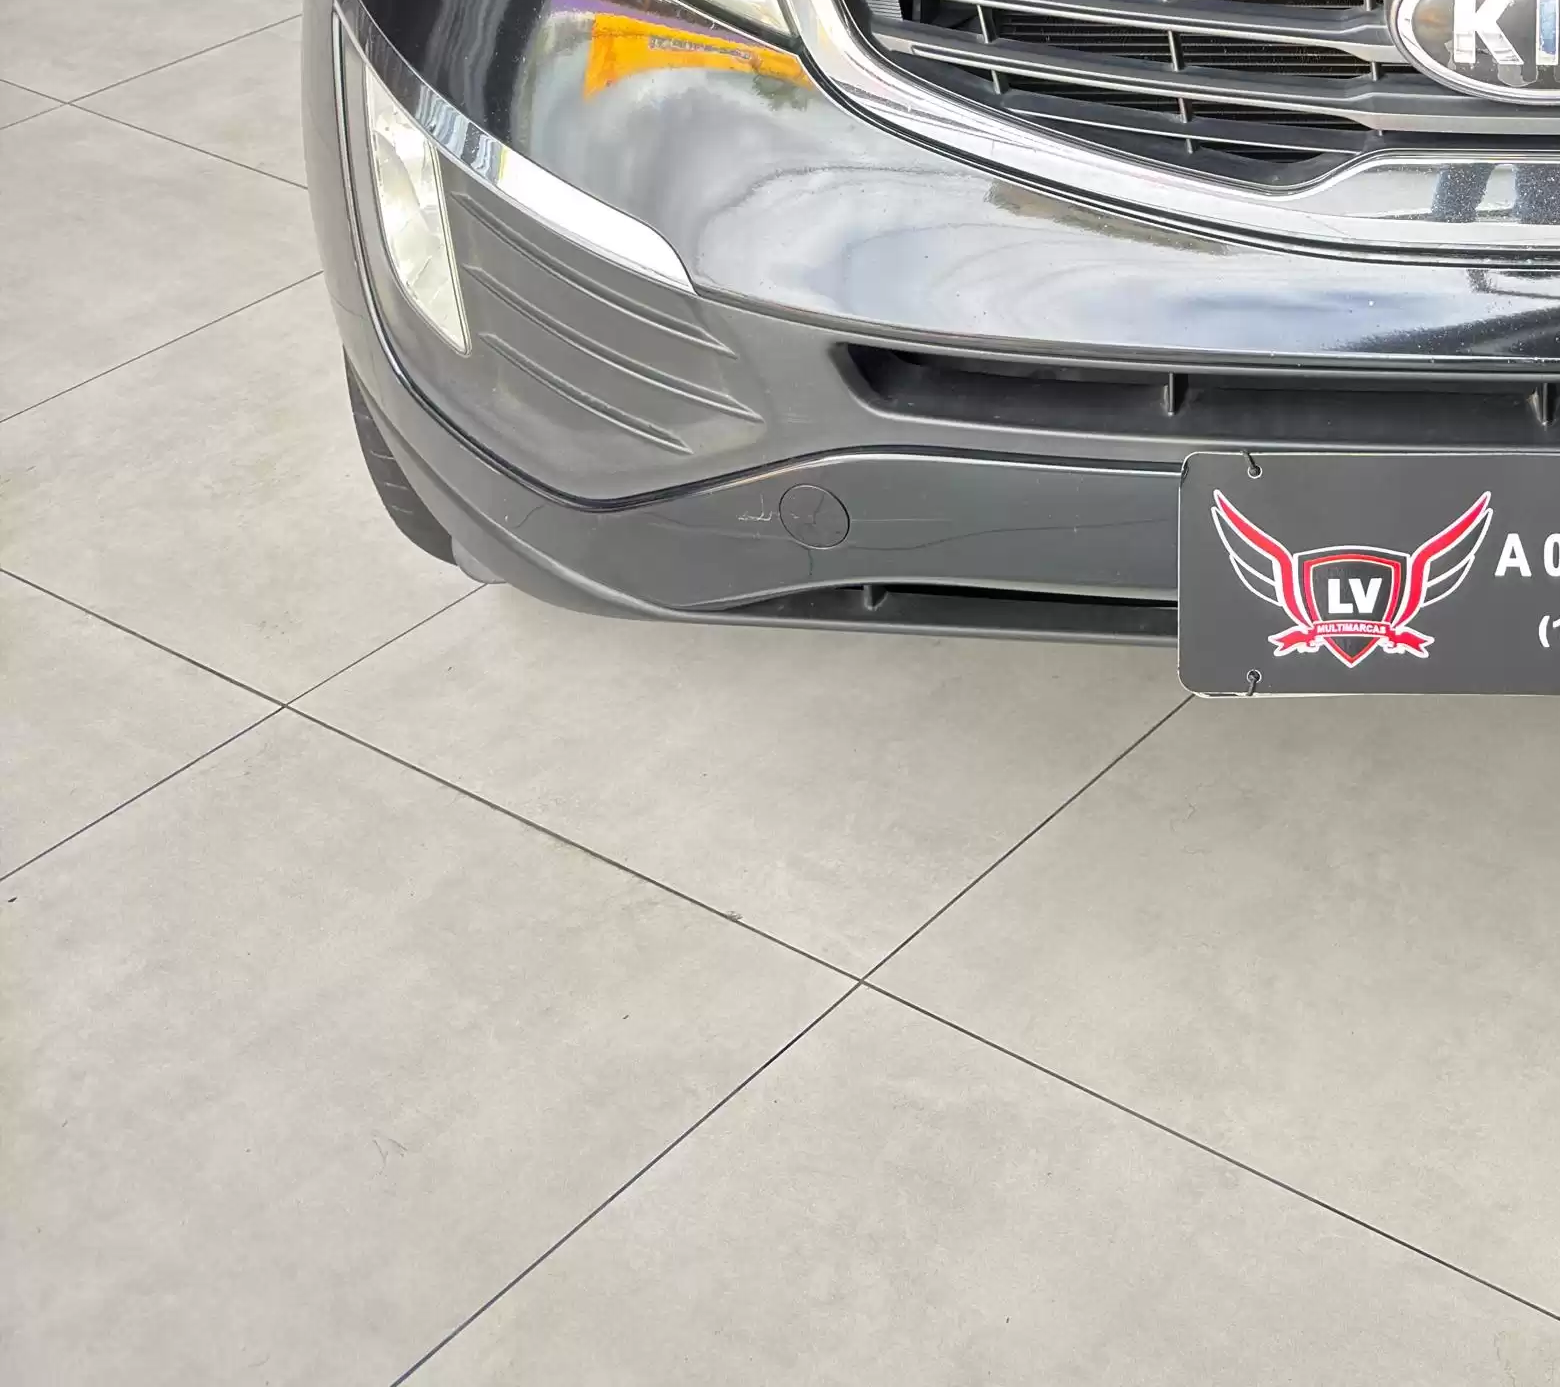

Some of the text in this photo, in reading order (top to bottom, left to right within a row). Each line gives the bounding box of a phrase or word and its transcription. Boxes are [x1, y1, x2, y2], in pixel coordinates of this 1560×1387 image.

[1494, 532, 1532, 577] A
[1327, 577, 1383, 614] LV
[1317, 623, 1386, 634] MULTIMARCAS
